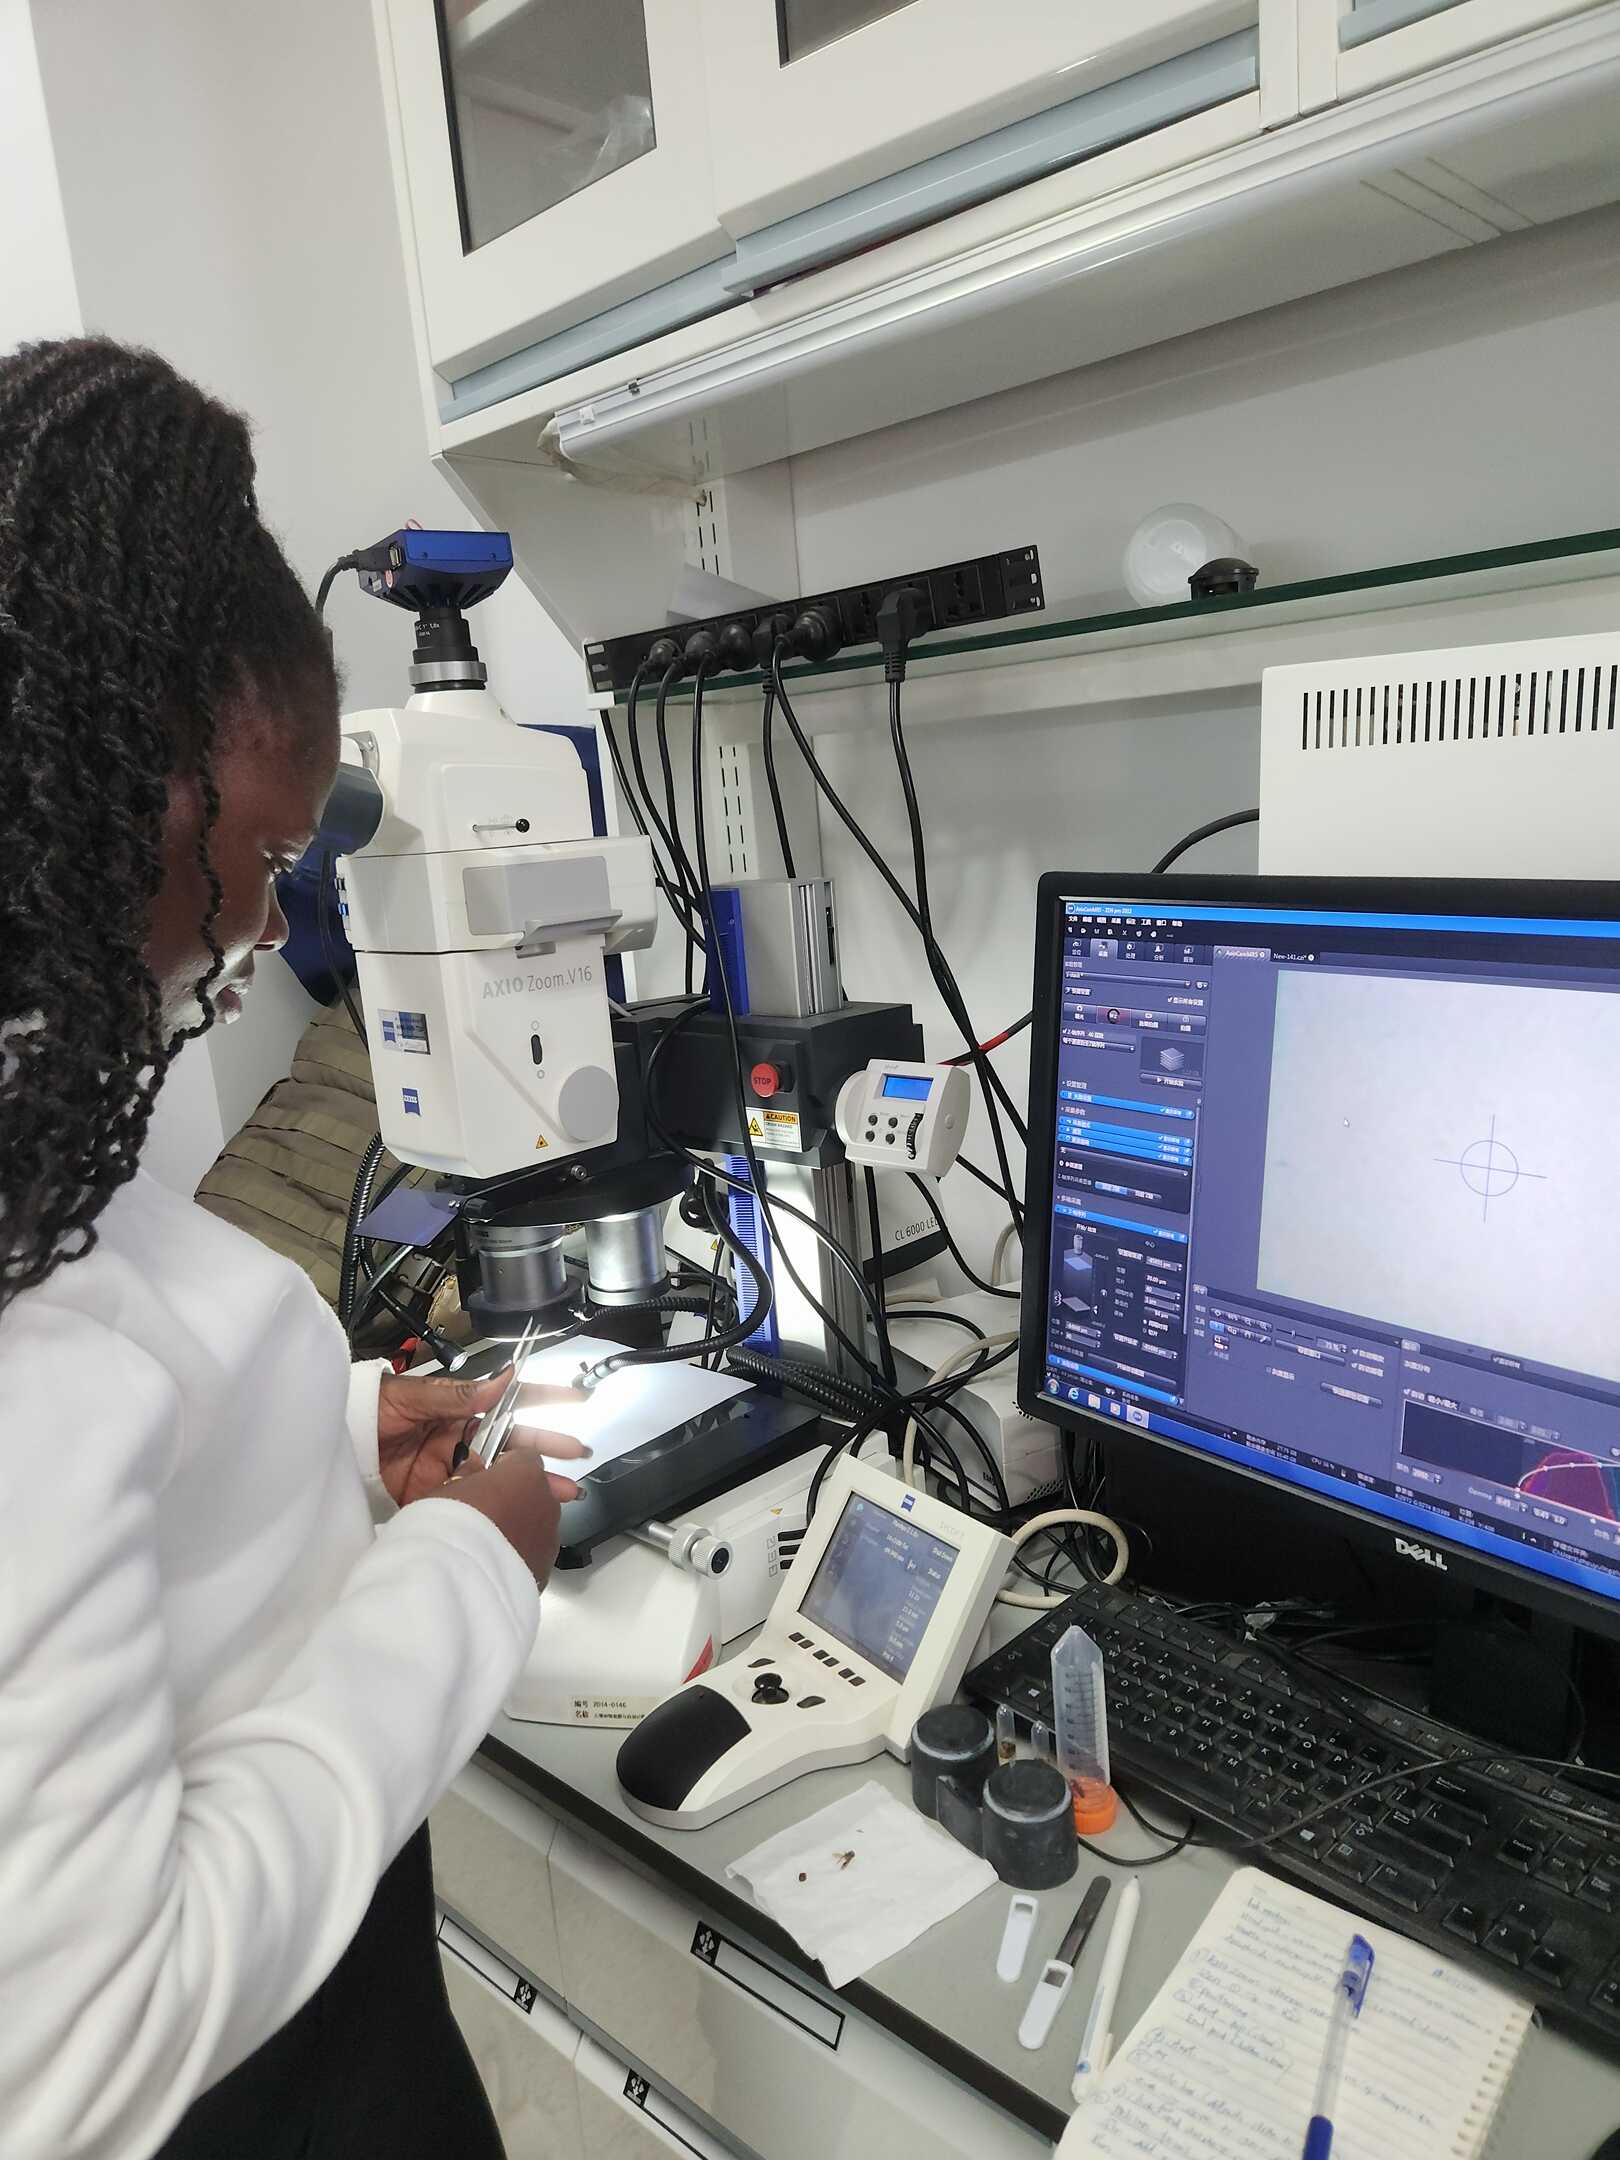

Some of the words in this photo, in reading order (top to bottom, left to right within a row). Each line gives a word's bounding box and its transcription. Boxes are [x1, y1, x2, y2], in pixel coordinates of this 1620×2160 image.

[482, 976, 524, 999] AXIO
[527, 965, 593, 992] Zoom.V16
[753, 1076, 772, 1085] STOP
[770, 1113, 796, 1123] CAUTION
[895, 1229, 905, 1241] CL
[905, 1221, 925, 1237] 6000
[1395, 1537, 1448, 1571] DELL
[1197, 1742, 1208, 1753] N
[1227, 1757, 1239, 1768] M
